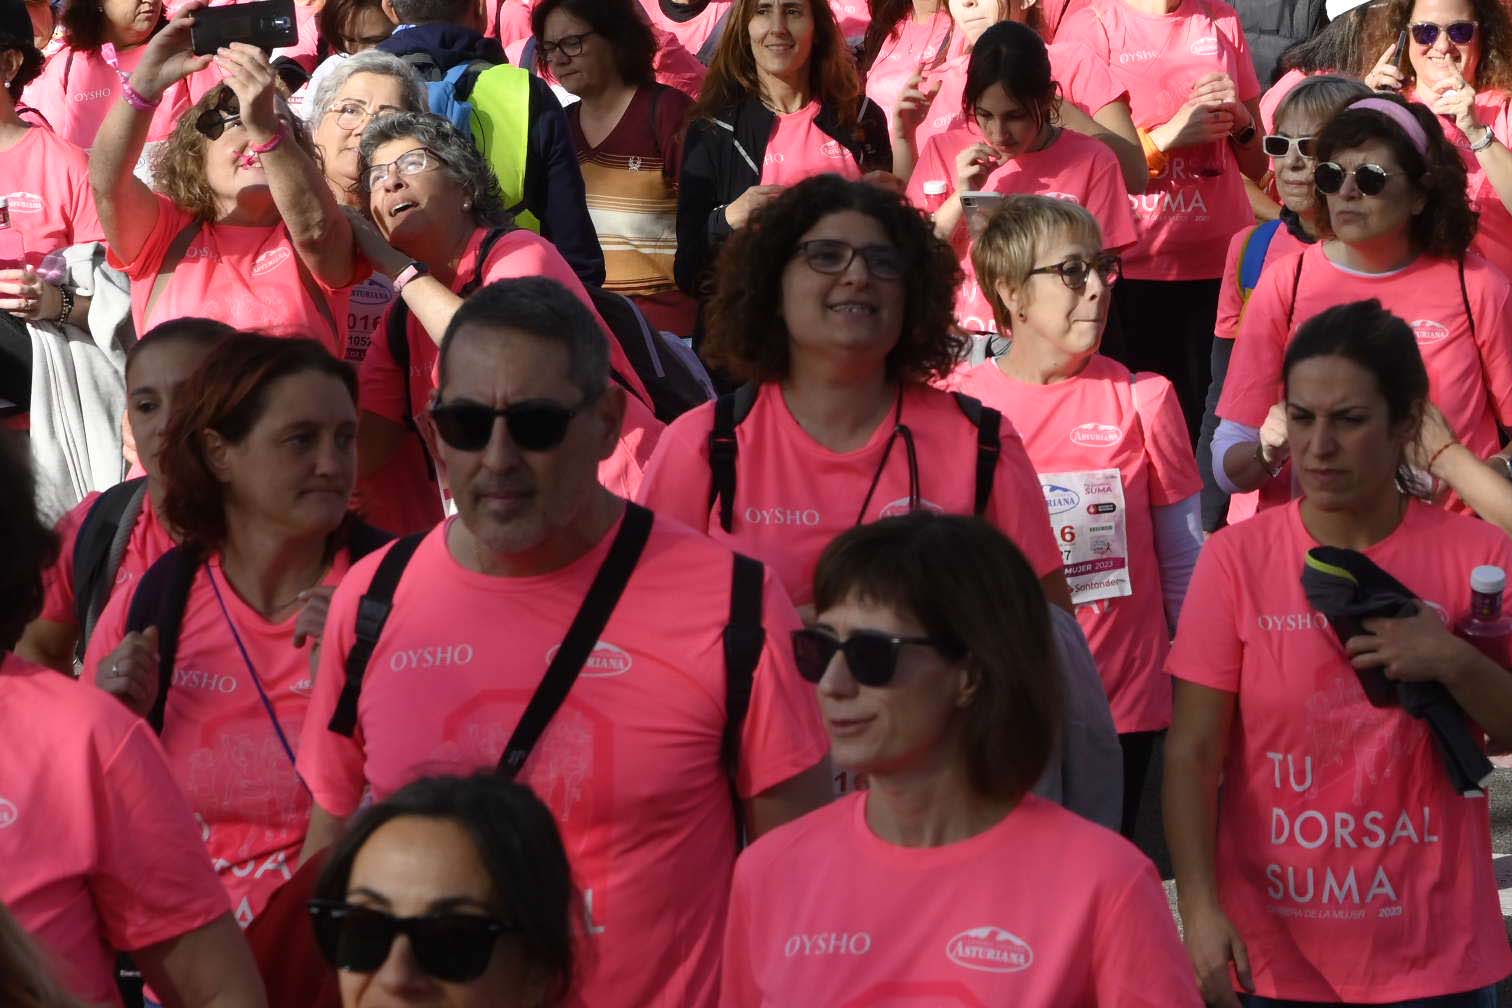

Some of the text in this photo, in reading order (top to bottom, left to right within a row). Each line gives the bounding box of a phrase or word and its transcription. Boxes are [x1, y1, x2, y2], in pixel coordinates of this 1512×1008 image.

[74, 87, 111, 104] OYSHO
[744, 507, 821, 526] OYSHO
[1257, 612, 1330, 633] OYSHO
[390, 643, 474, 673] OYSHO
[1266, 751, 1313, 793] TU
[1271, 806, 1440, 850] DORSAL
[1266, 863, 1399, 905] SUMA
[784, 931, 872, 958] OYSHO
[955, 940, 1026, 966] ASTURIANA
